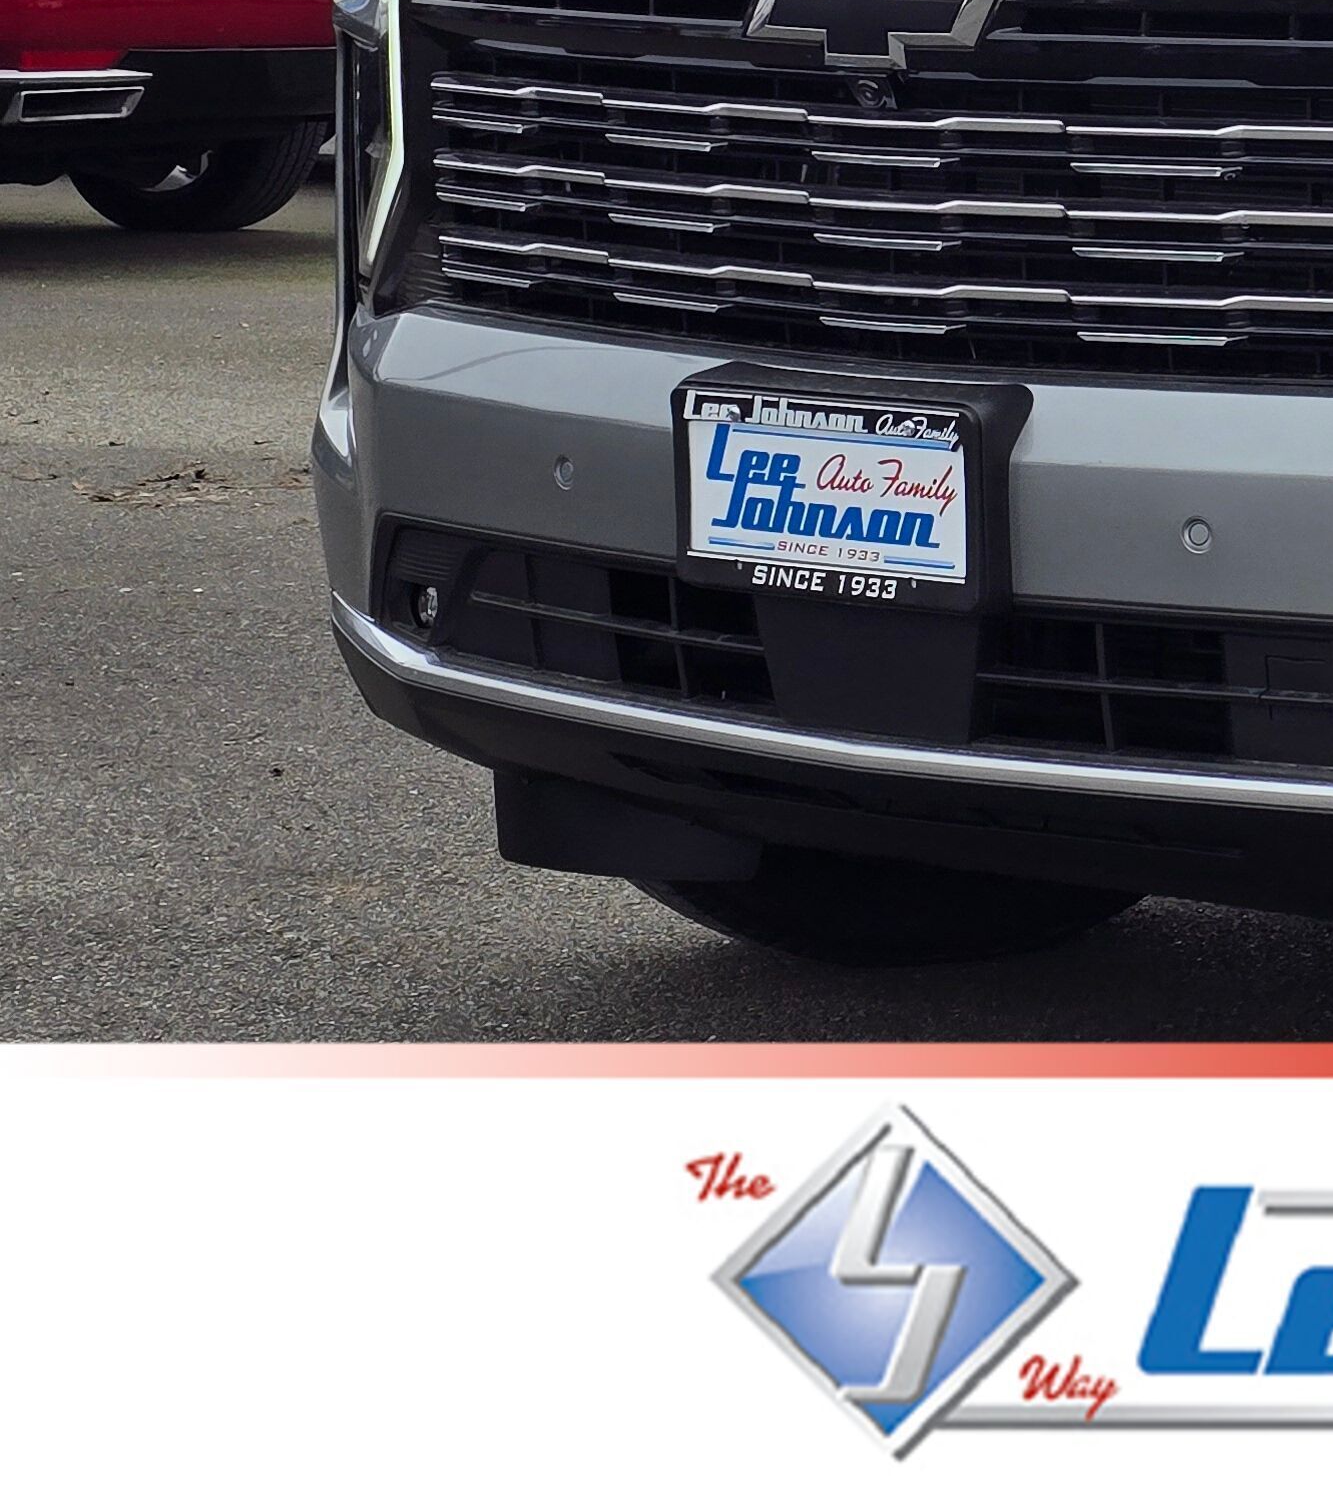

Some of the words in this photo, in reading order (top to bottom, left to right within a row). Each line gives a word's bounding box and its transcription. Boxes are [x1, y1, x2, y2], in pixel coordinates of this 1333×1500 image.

[745, 395, 869, 434] Johnson
[706, 423, 806, 489] Lee
[816, 453, 874, 493] Auto
[878, 458, 958, 517] Family
[711, 479, 940, 549] Johnson
[777, 540, 829, 557] SINCE
[837, 548, 880, 564] 1933
[752, 565, 827, 593] SINCE
[836, 574, 899, 600] 1933
